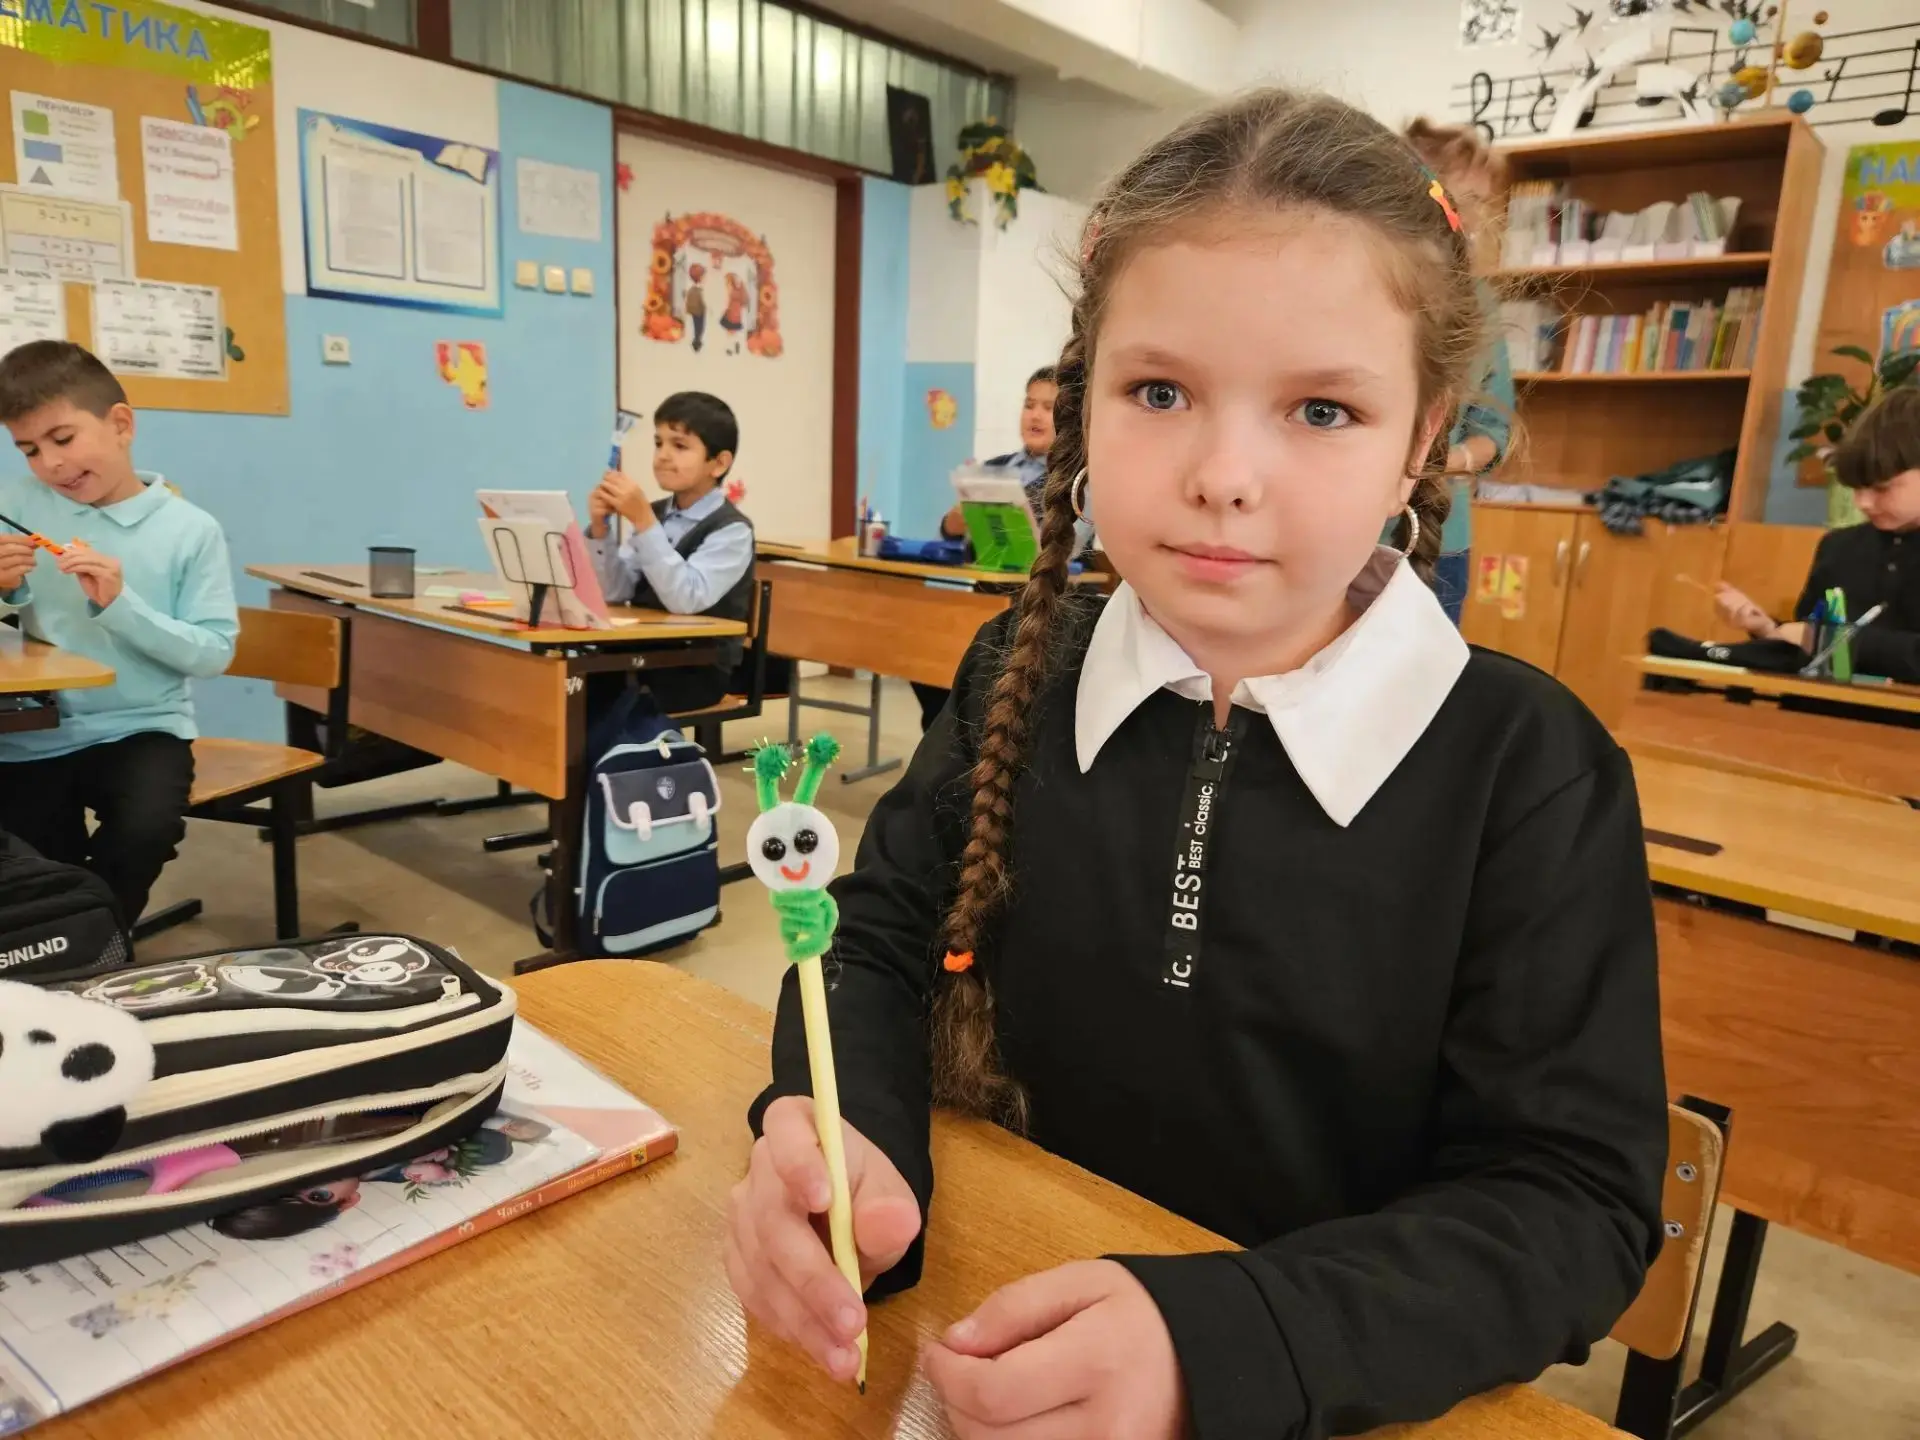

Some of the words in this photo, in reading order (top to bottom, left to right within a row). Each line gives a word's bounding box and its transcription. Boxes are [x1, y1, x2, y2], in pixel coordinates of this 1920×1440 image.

[1194, 782, 1214, 835] classic.
[1188, 839, 1204, 869] BEST
[1171, 854, 1202, 931] BEST
[496, 1198, 533, 1218] Часть
